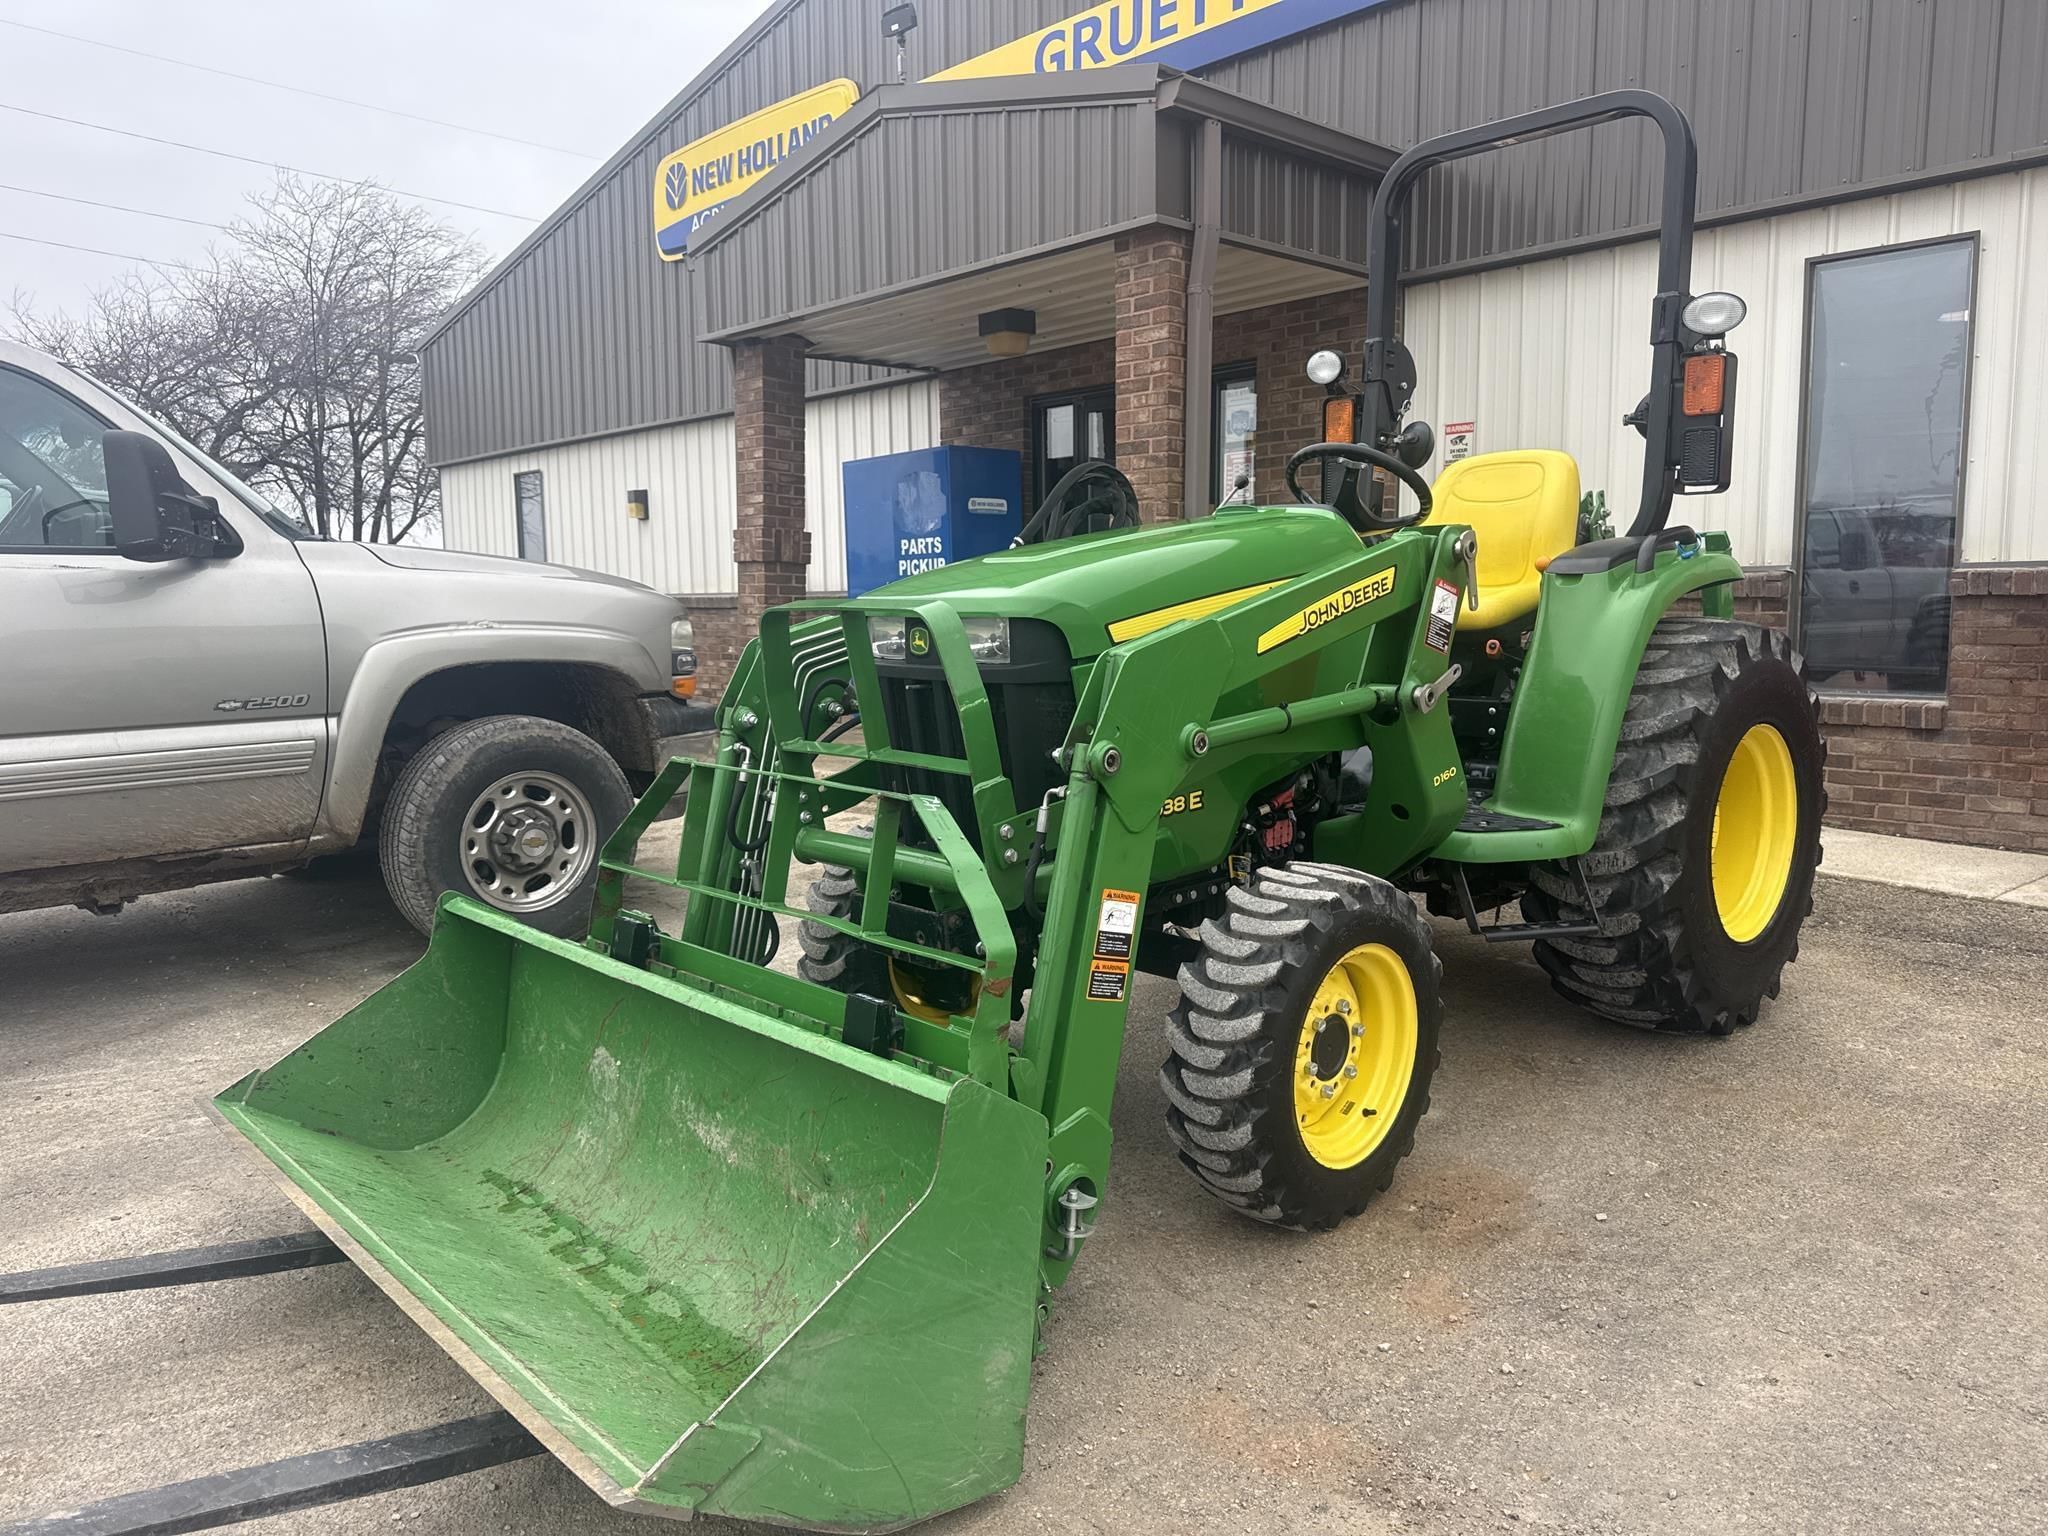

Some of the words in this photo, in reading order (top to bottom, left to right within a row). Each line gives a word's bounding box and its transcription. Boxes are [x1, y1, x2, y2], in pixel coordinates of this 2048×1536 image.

[1034, 0, 1243, 73] GRUE
[692, 152, 733, 197] NEW
[901, 536, 943, 555] PARTS
[898, 557, 946, 576] PICKUP
[1299, 598, 1340, 632] JOHN
[1342, 576, 1390, 611] DEERE
[245, 694, 309, 710] 2500
[1433, 766, 1457, 787] D160
[1160, 796, 1186, 815] 38
[1189, 790, 1202, 810] E
[1111, 892, 1136, 901] WARNING
[1102, 964, 1125, 972] WARNING
